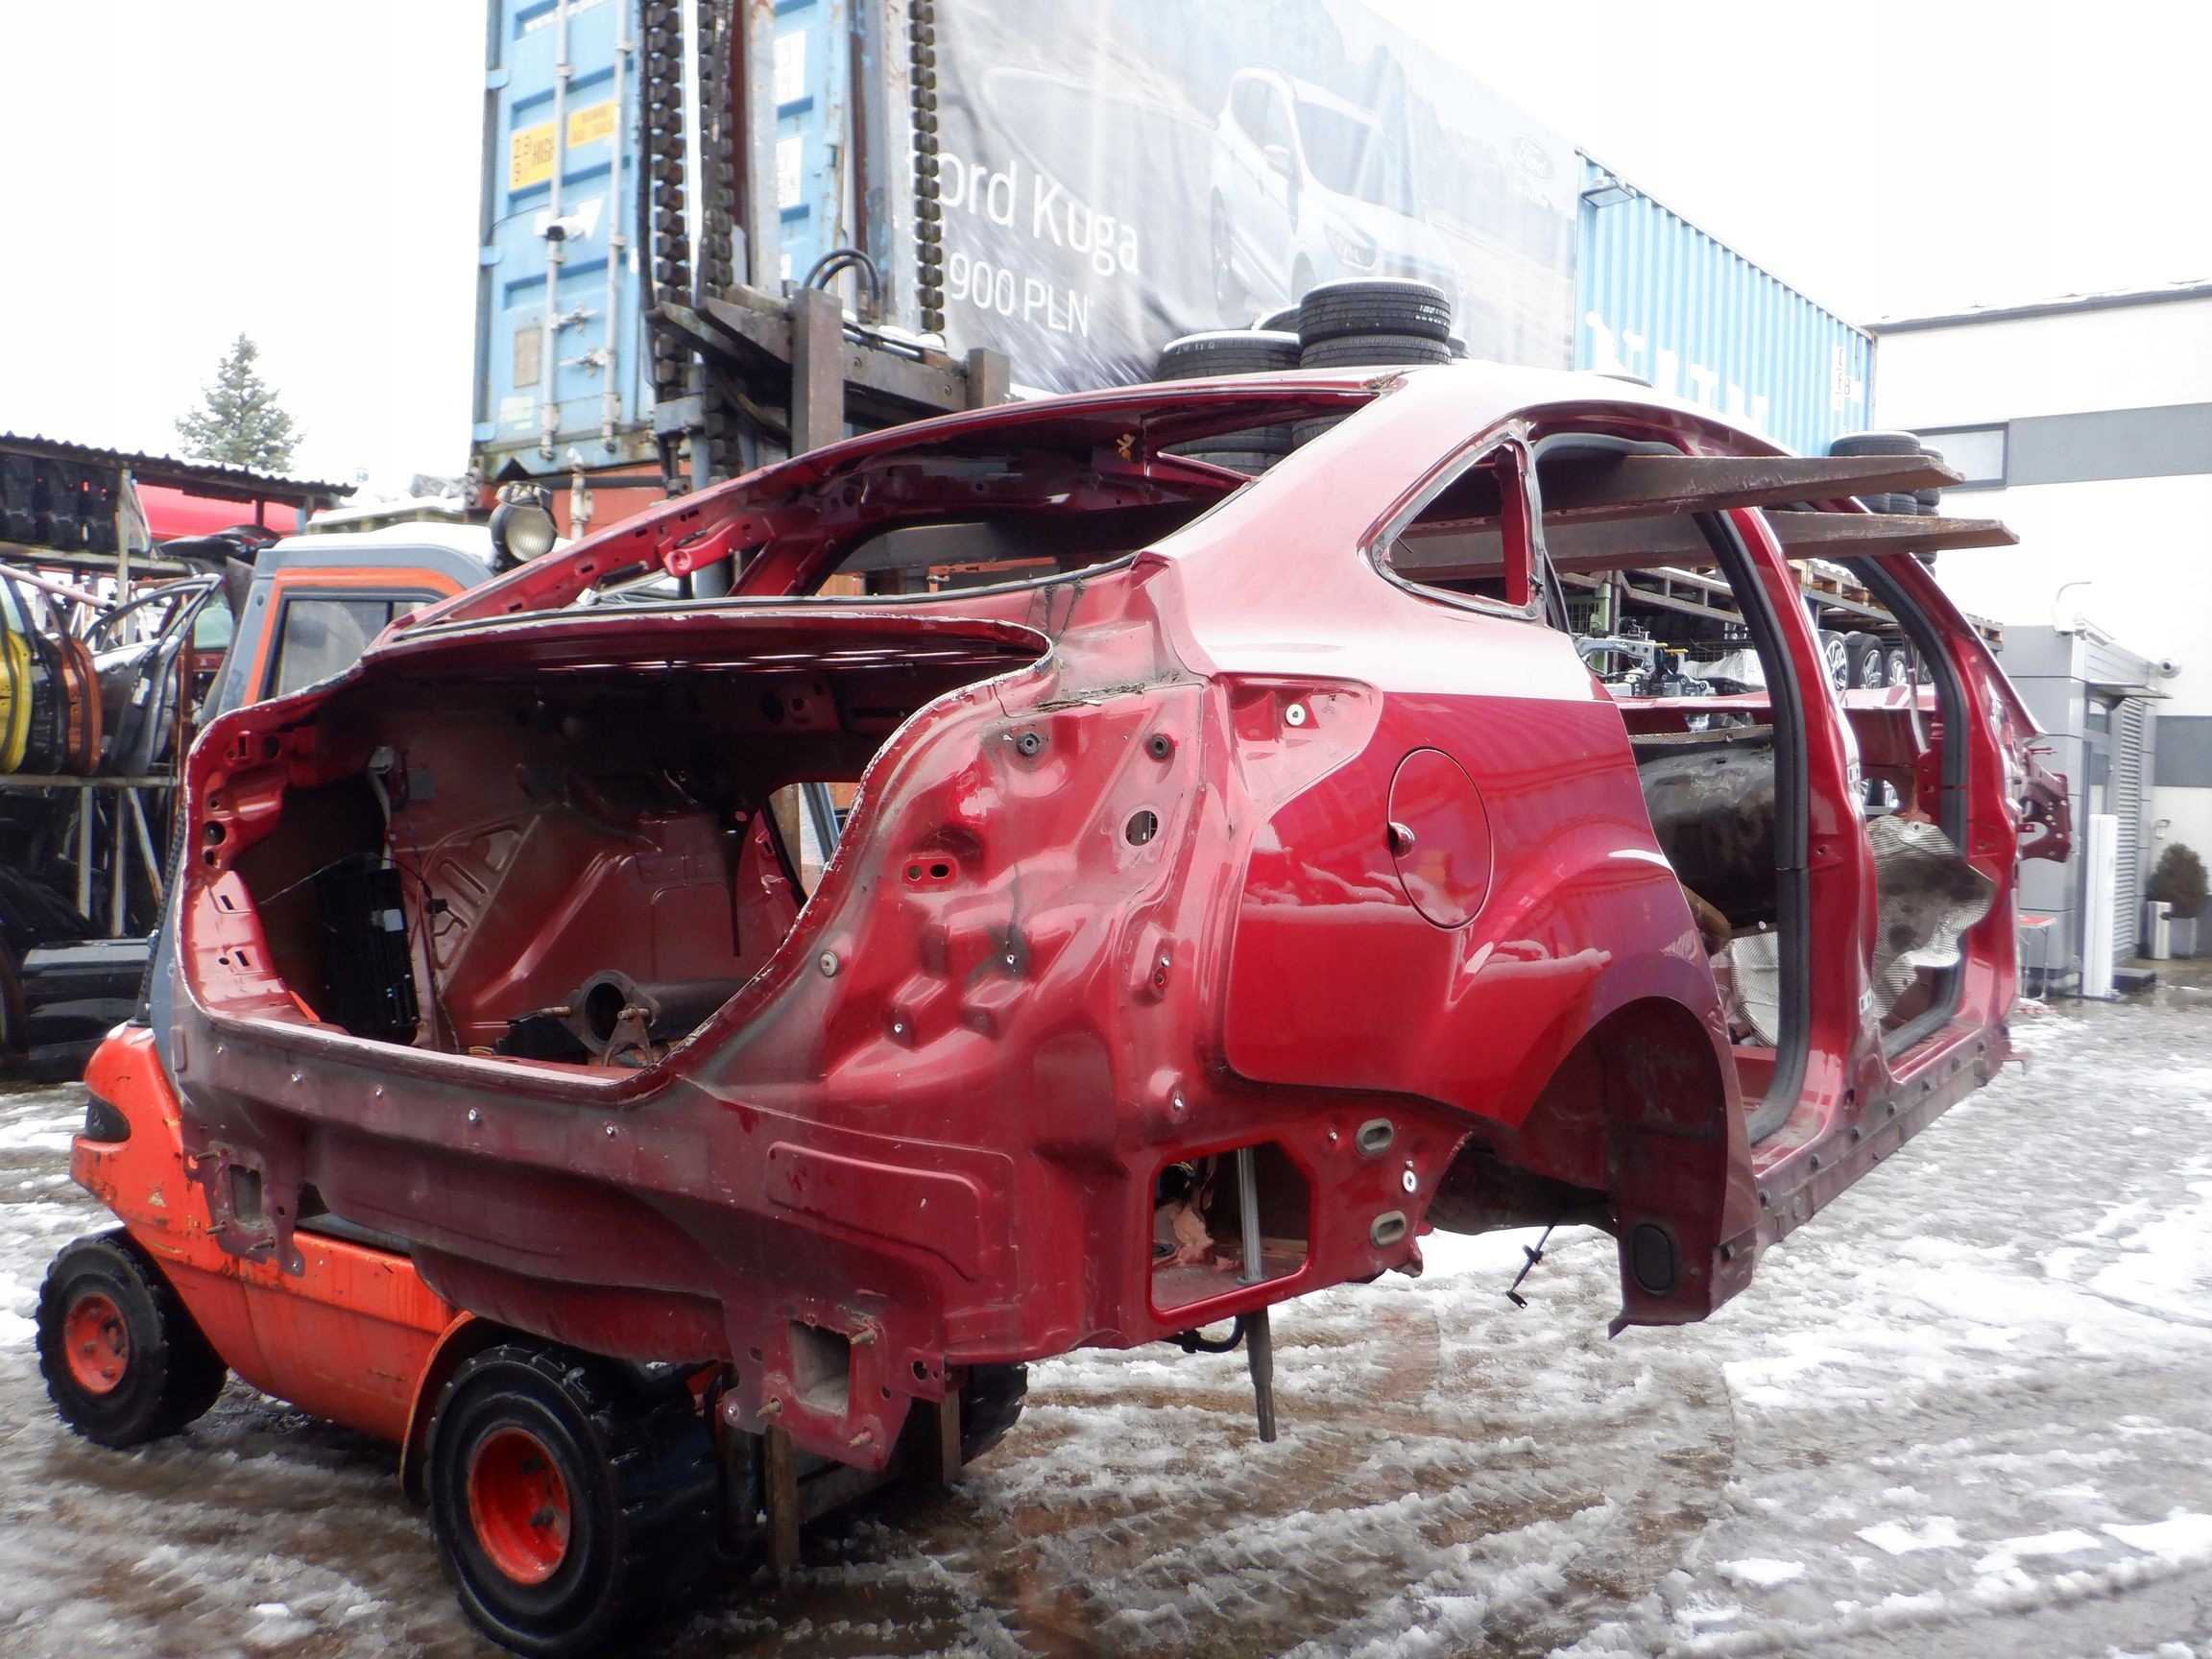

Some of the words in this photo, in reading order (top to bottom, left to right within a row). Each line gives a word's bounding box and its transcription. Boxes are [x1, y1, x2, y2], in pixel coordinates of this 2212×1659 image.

[937, 152, 1018, 228] ord
[1033, 173, 1141, 276] Kuga
[948, 252, 1015, 317] 900
[1023, 276, 1090, 337] PLN
